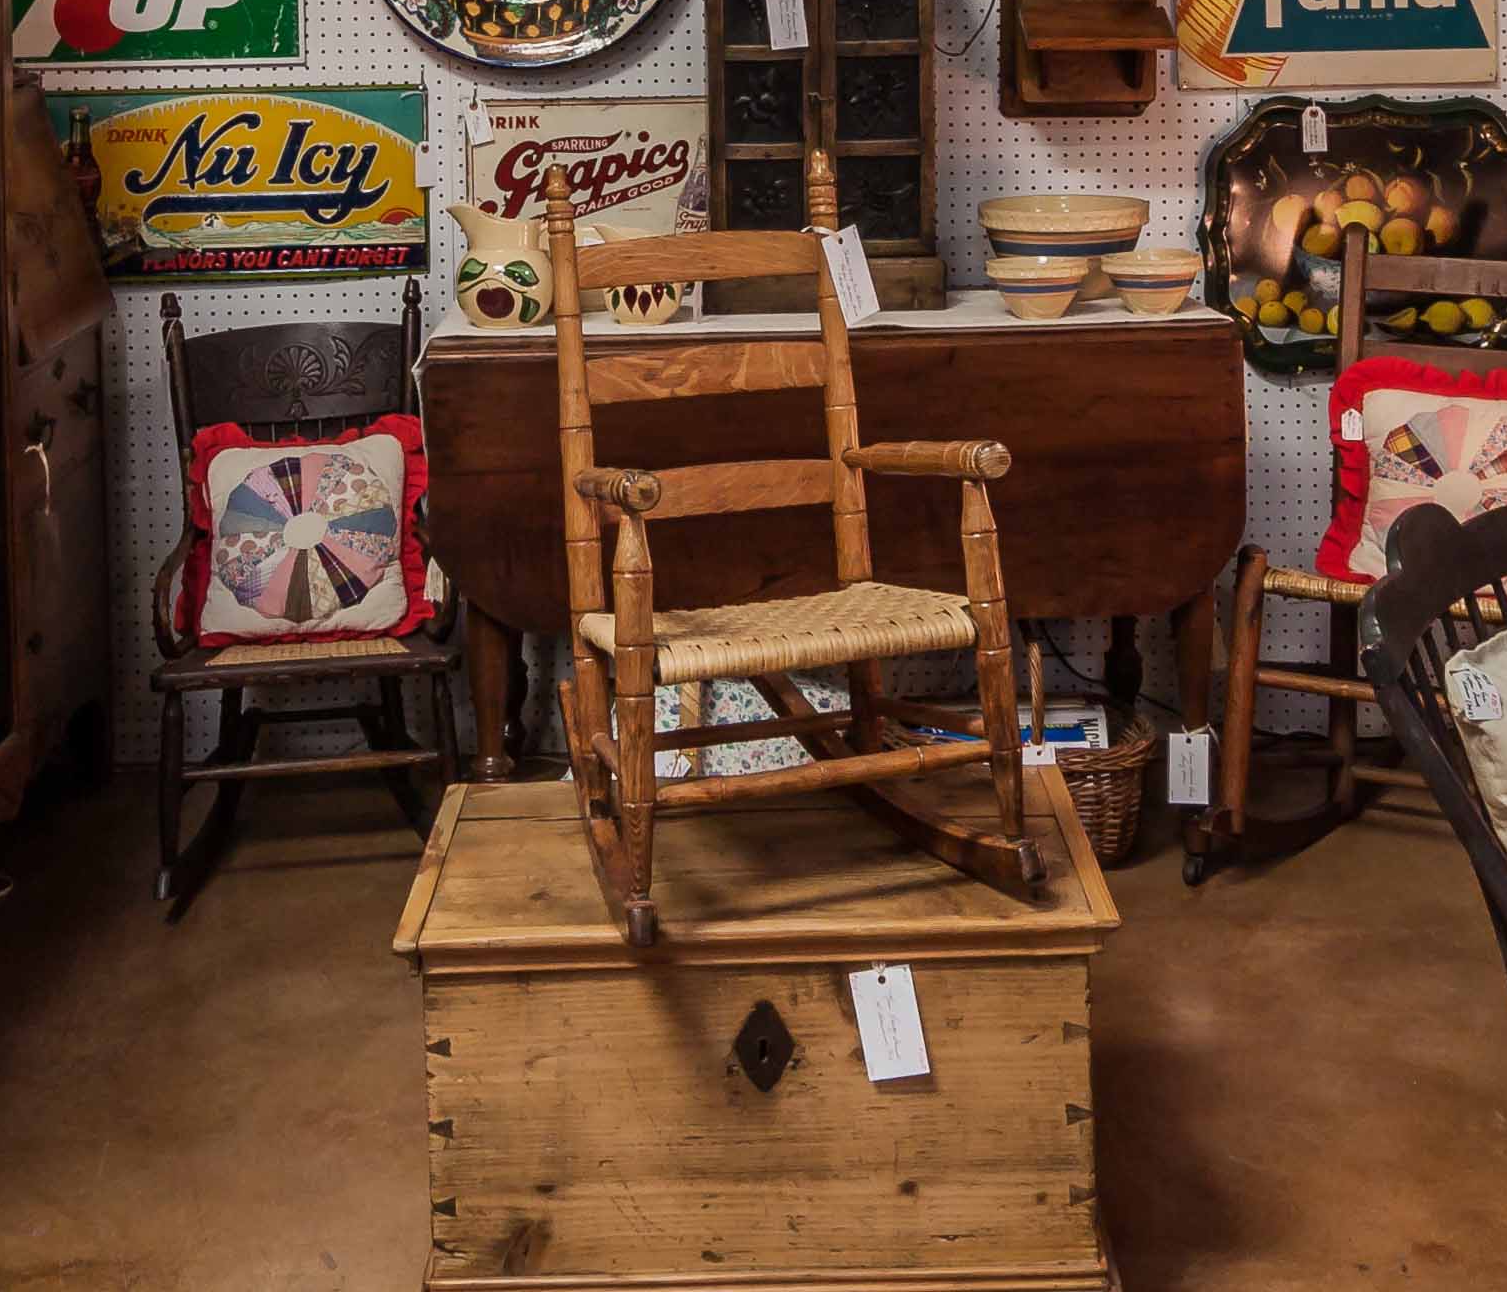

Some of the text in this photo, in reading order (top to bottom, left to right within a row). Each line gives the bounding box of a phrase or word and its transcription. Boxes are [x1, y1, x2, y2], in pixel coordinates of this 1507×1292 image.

[490, 115, 541, 129] RINK
[106, 127, 171, 145] DRINK
[551, 138, 609, 152] SPARKLING
[124, 112, 392, 218] Nu Icy
[575, 175, 675, 217] RALLY GOOD
[231, 250, 274, 270] YOU
[331, 246, 410, 268] FORGET
